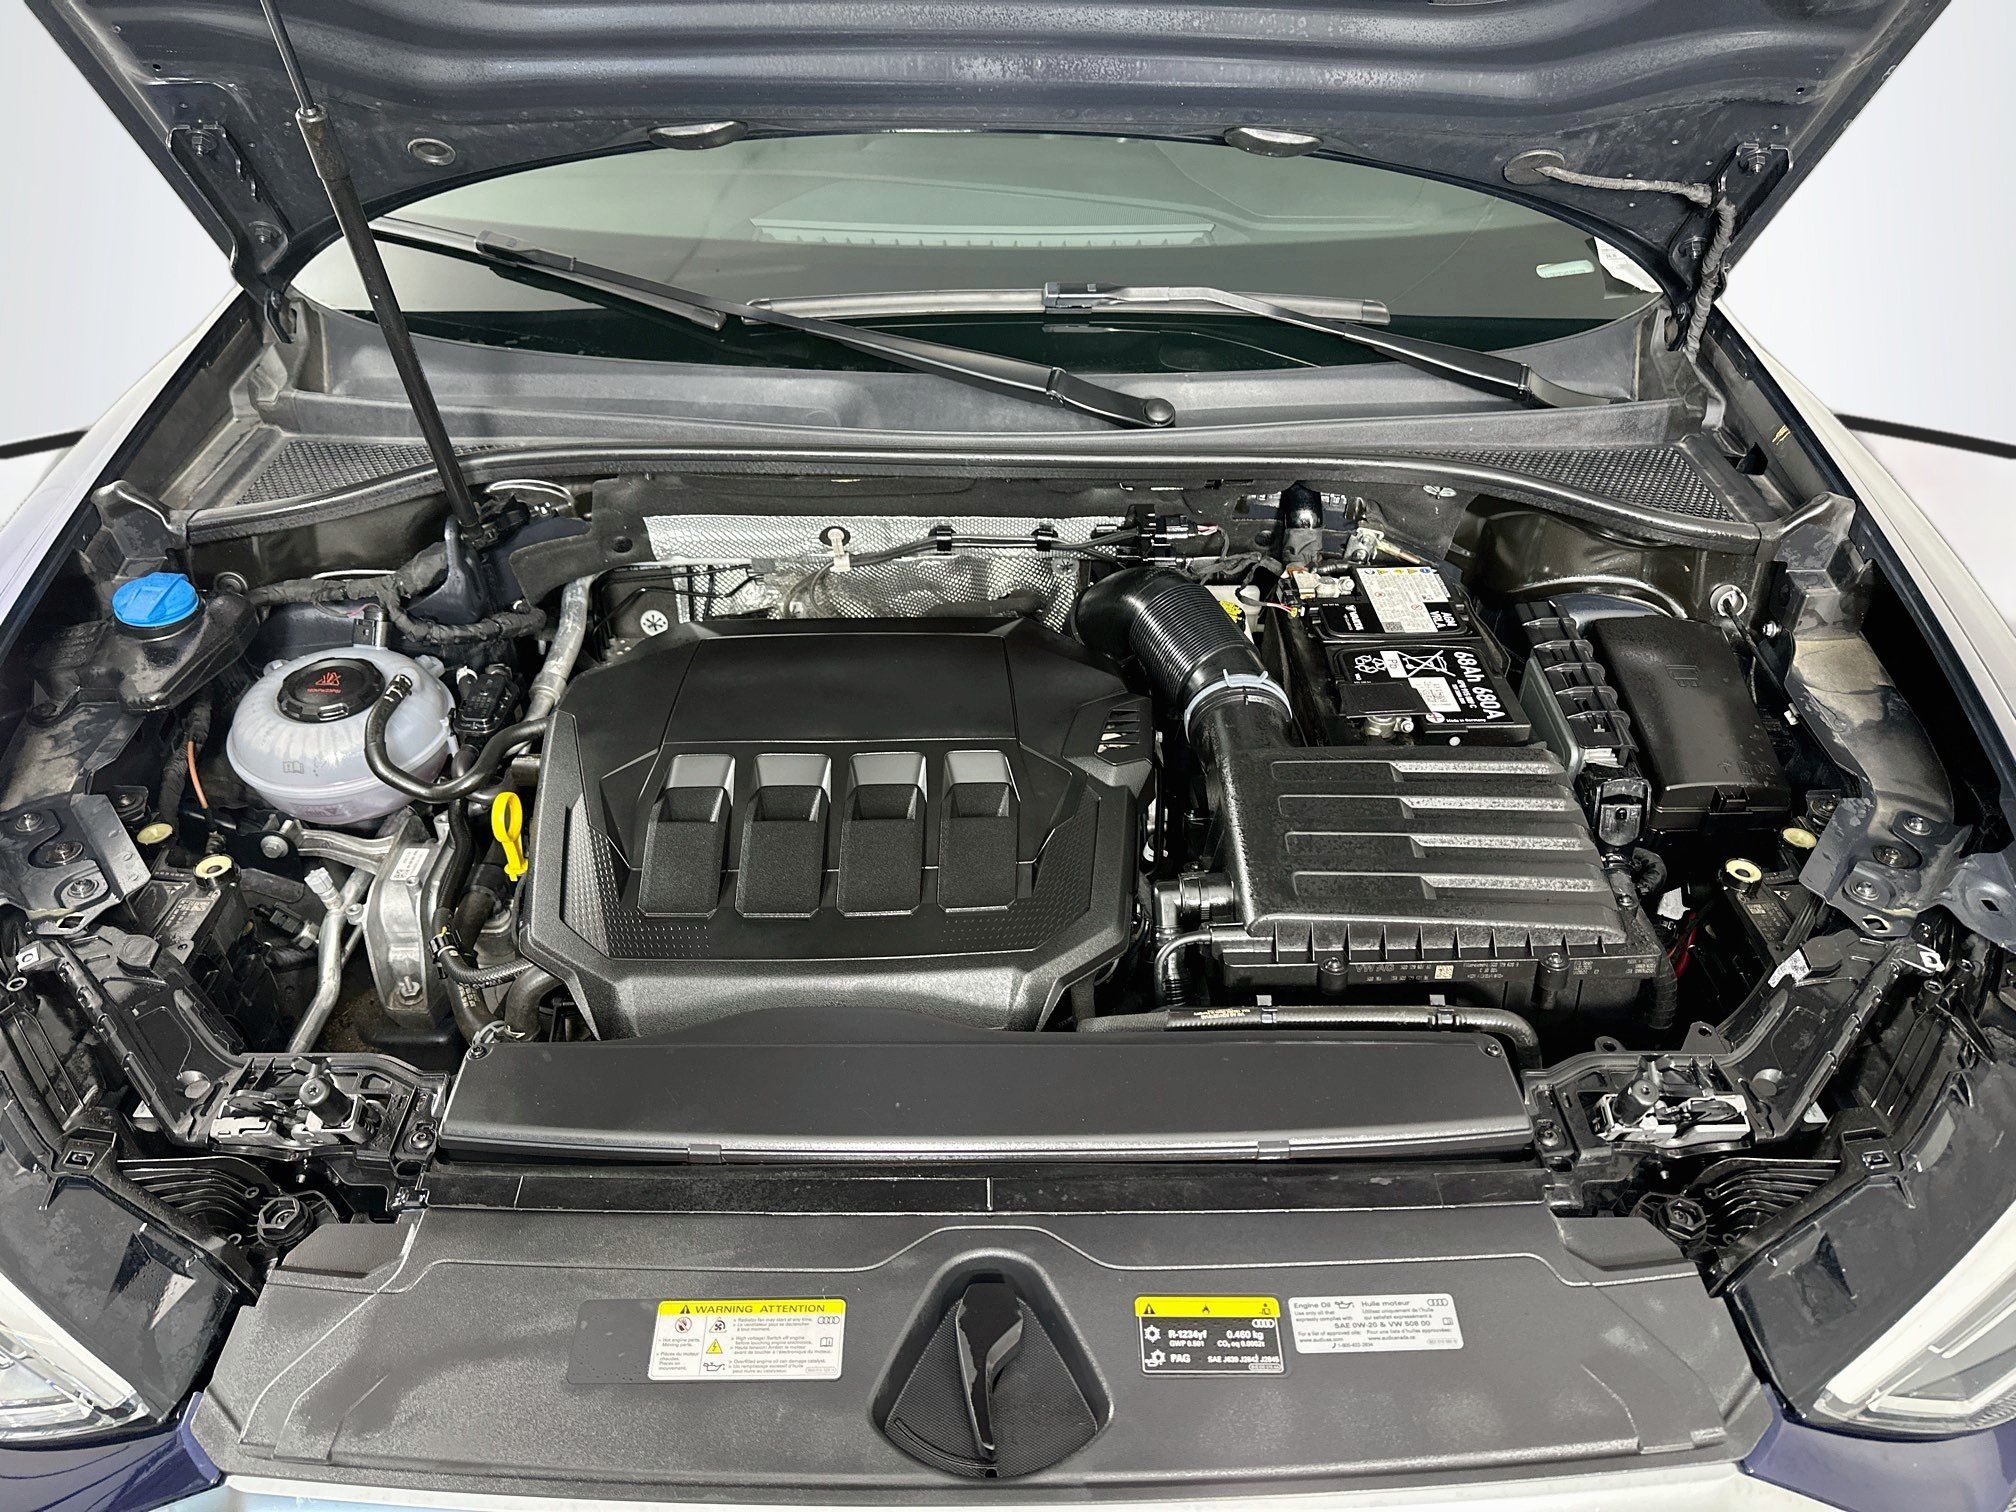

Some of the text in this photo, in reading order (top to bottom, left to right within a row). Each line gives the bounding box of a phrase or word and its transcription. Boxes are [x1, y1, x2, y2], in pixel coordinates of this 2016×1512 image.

[1441, 612, 1457, 626] AGM
[1454, 652, 1485, 682] 68Ah
[1472, 687, 1506, 719] 680A
[696, 1305, 753, 1313] WARNING
[1168, 1330, 1207, 1340] R-1234yf
[1252, 1330, 1264, 1340] kg
[1170, 1354, 1191, 1363] PAG
